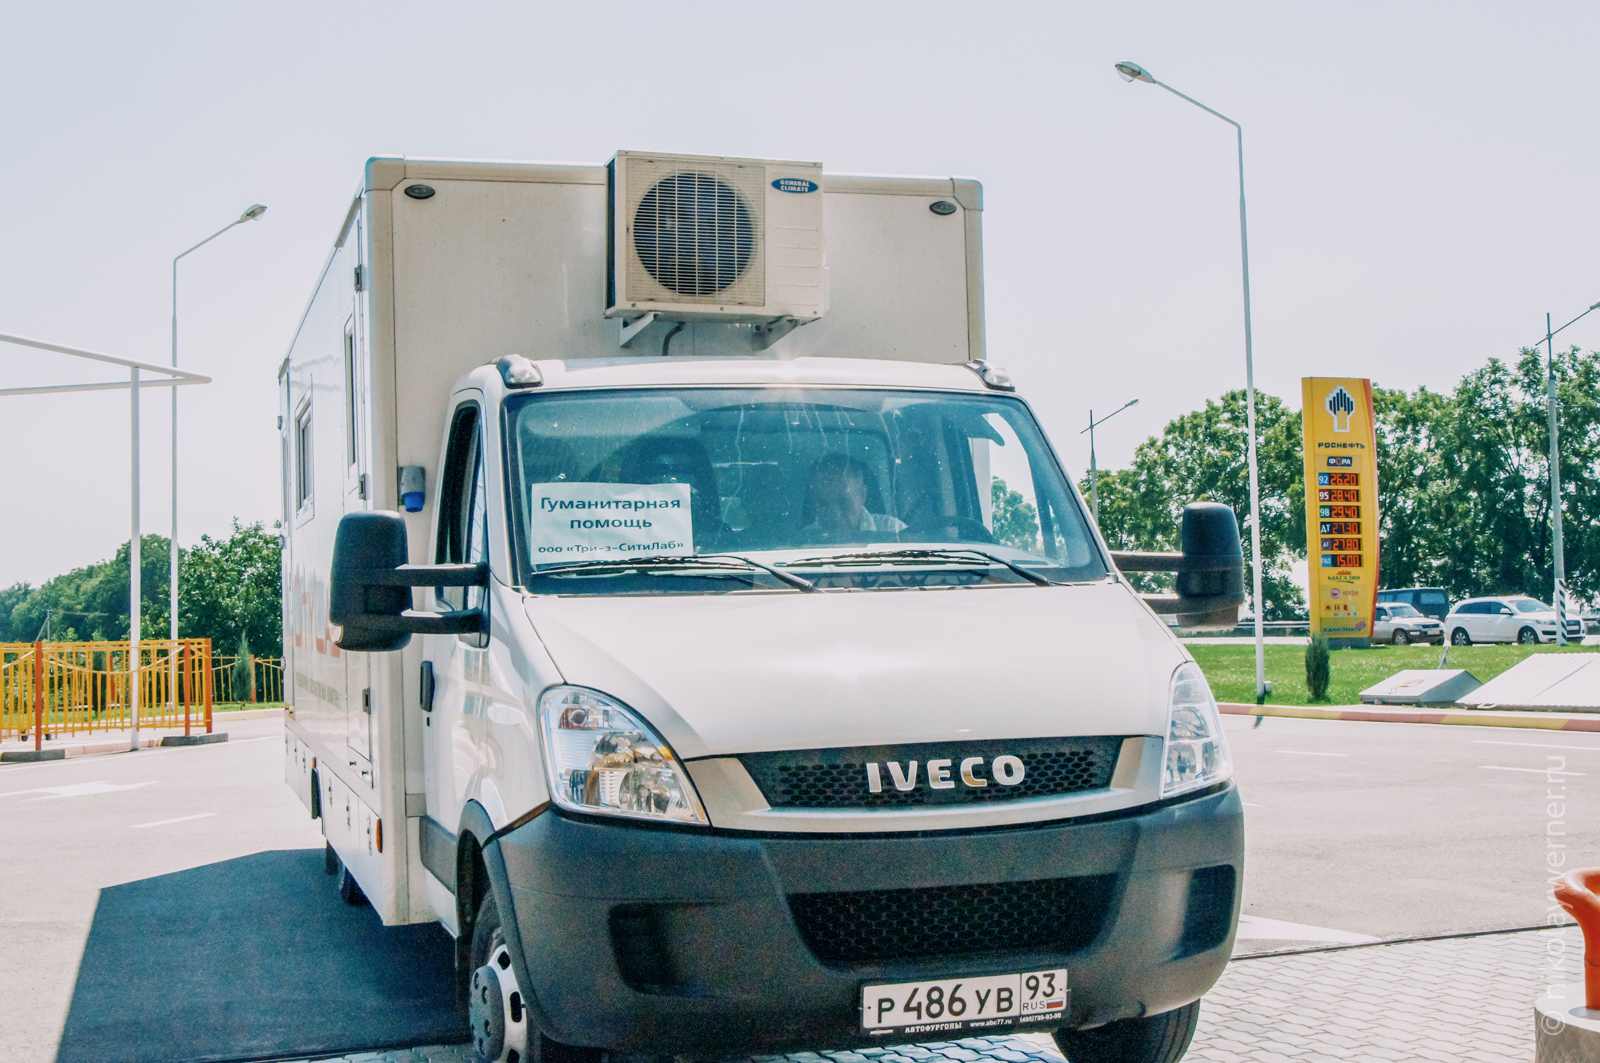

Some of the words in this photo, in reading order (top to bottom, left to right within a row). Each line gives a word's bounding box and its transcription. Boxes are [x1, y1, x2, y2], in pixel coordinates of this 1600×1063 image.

[1319, 476, 1328, 484] 92
[1330, 474, 1356, 486] 26.20
[1319, 491, 1329, 500] 95
[1331, 490, 1357, 502] 28.40
[541, 497, 681, 512] Гуманитарная
[1320, 508, 1329, 516] 98
[1332, 506, 1357, 518] 29.40
[570, 519, 653, 530] помощь
[1332, 522, 1358, 534] 27.30
[1333, 538, 1359, 551] 27.80
[1337, 554, 1360, 567] 15.00
[866, 755, 1025, 793] IVECO
[1025, 973, 1056, 1000] 93
[1022, 1000, 1046, 1011] RUS
[904, 1021, 962, 1034] АВТОФУРГОНЫ
[969, 1018, 1012, 1028] www.abc77.ru
